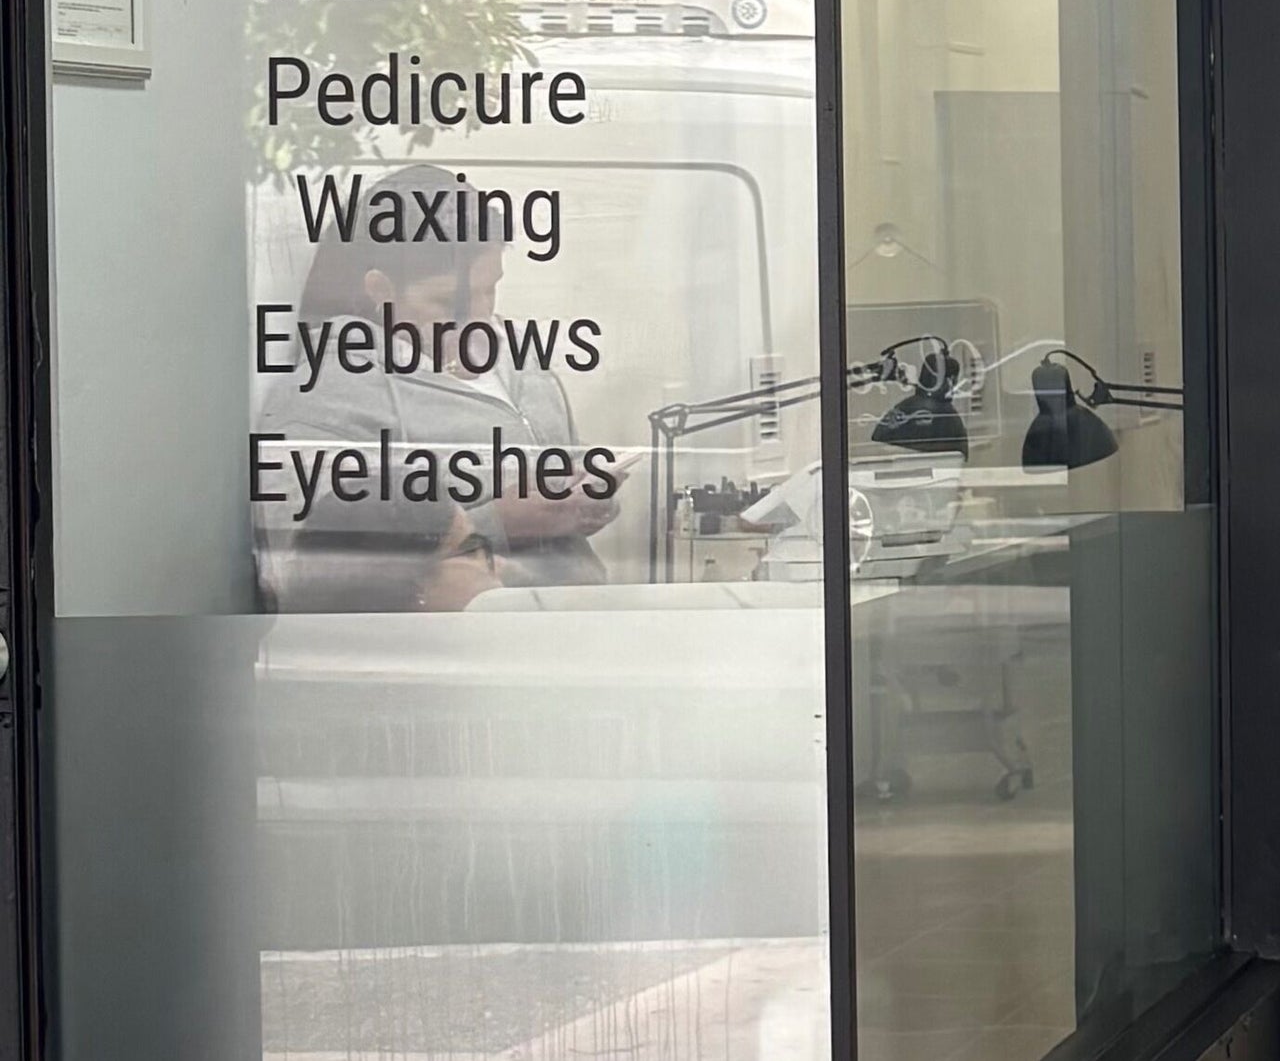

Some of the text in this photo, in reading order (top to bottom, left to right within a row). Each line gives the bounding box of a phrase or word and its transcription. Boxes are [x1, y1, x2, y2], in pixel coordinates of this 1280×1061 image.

[269, 53, 585, 125] Pedicure
[297, 174, 559, 261] Waxing
[257, 303, 600, 392] Eyebrows
[250, 427, 616, 519] Eyelashes
